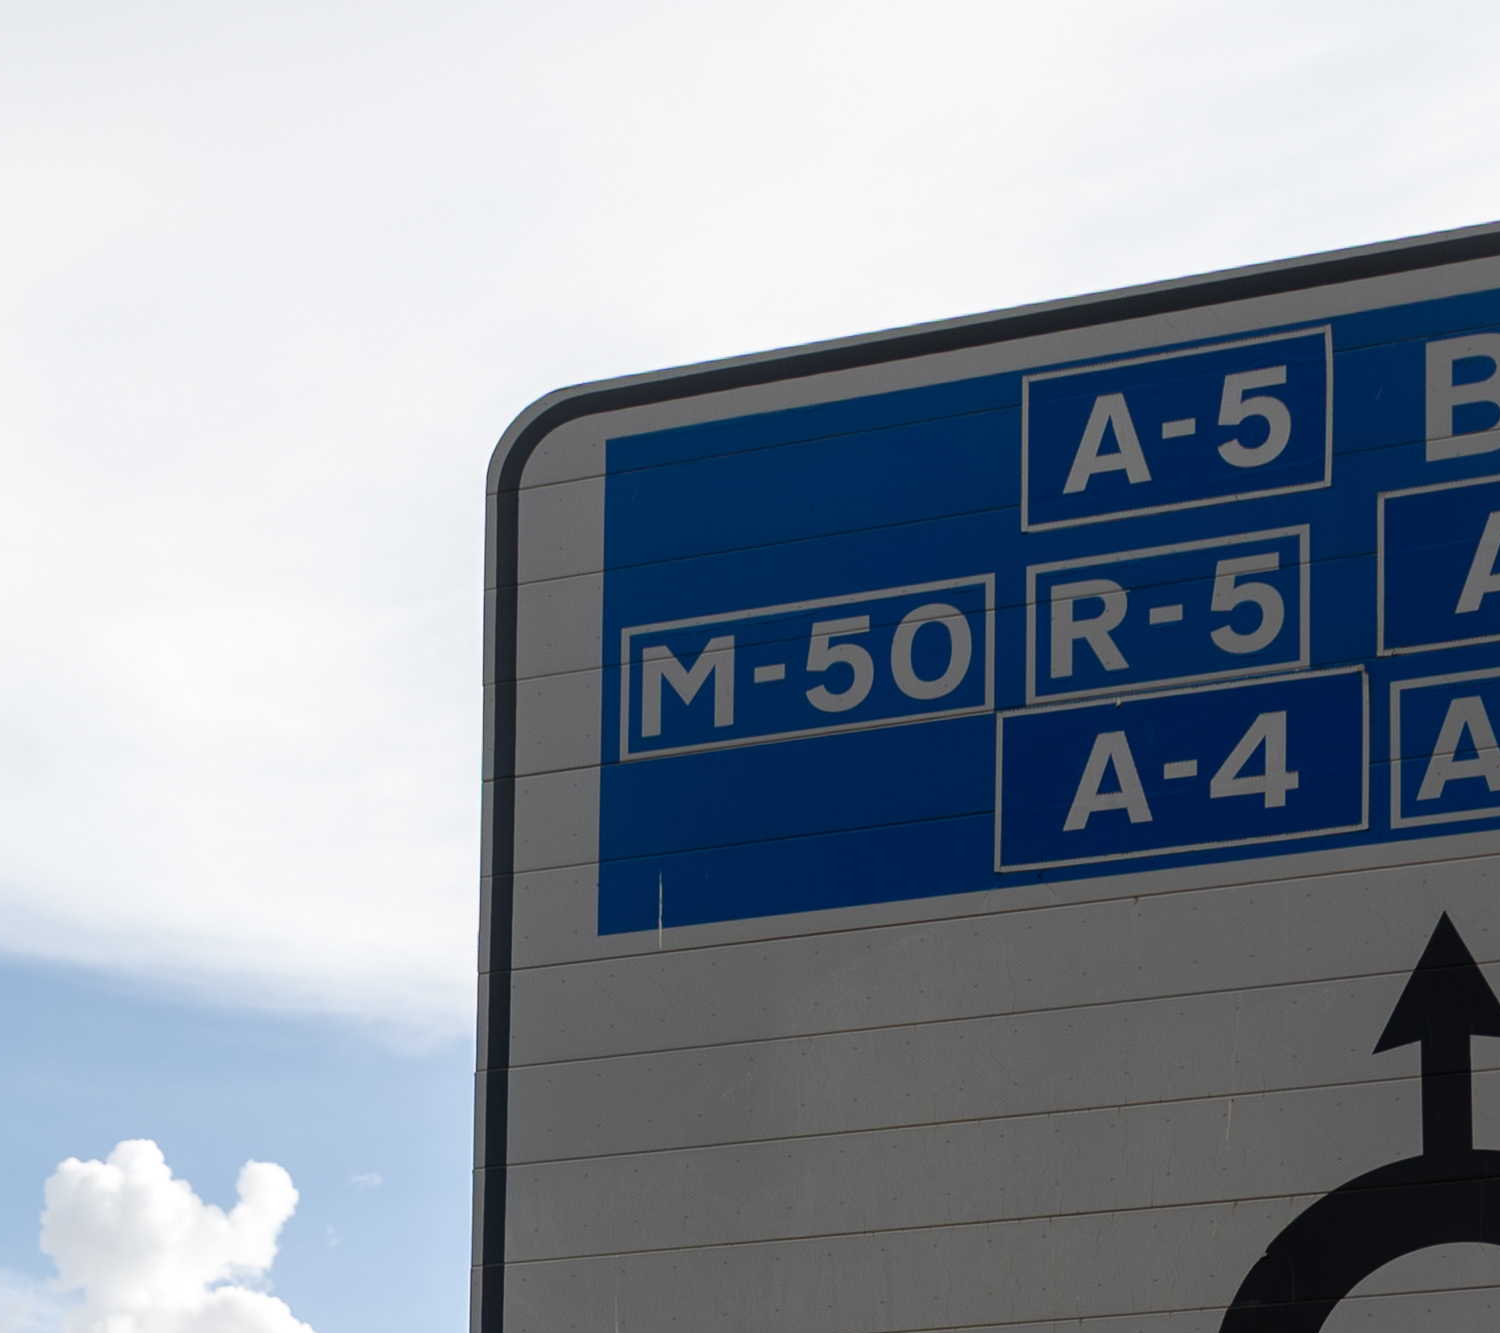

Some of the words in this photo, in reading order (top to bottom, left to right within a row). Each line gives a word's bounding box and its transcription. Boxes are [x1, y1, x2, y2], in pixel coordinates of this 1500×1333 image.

[1062, 364, 1292, 494] A-5
[641, 603, 972, 738] M-50
[1050, 552, 1285, 679] R-5
[1062, 710, 1299, 832] A-4
